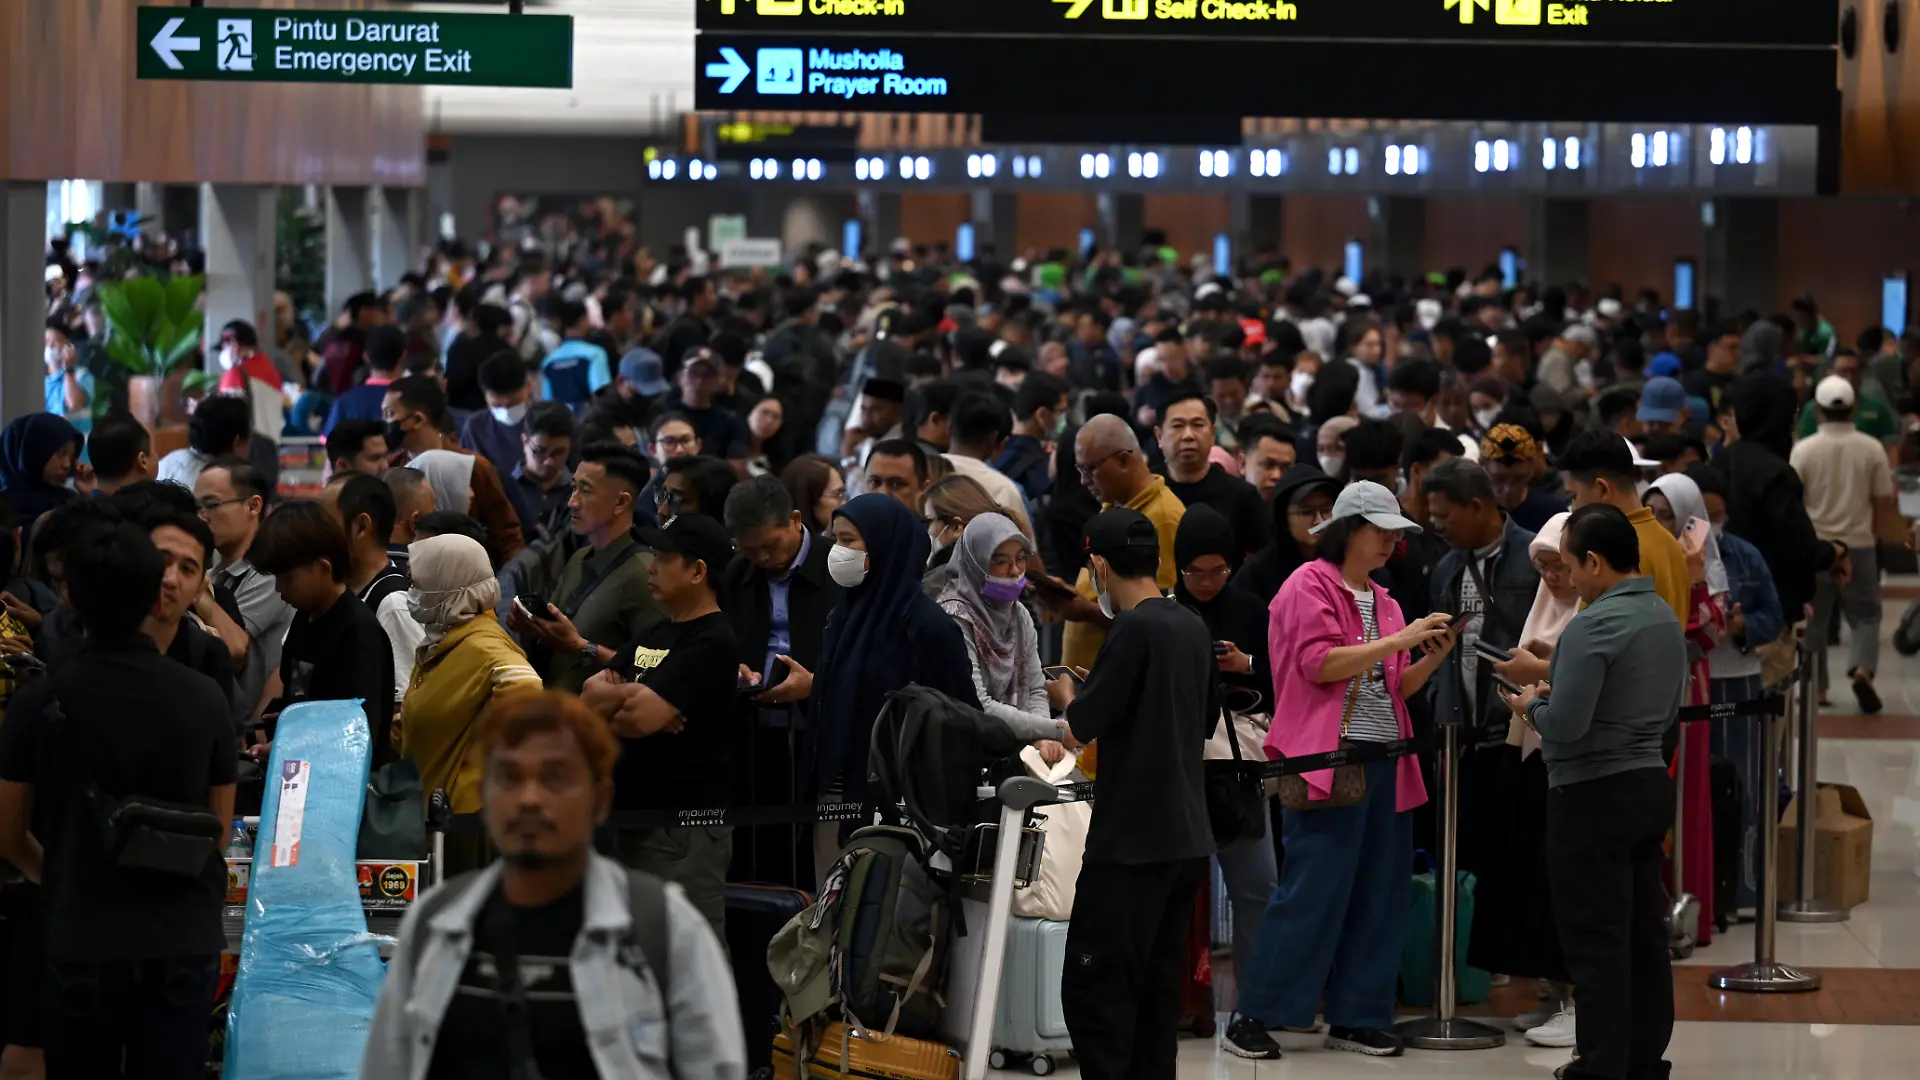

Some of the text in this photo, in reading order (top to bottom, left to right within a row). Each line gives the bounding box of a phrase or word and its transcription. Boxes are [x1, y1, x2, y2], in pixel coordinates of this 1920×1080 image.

[809, 0, 904, 16] Check-In
[1155, 0, 1296, 20] Self Check-In
[1547, 3, 1588, 25] Exit
[274, 17, 440, 42] Pintu Darurat
[275, 45, 471, 76] Emergency Exit
[809, 47, 904, 71] Musholla
[809, 72, 947, 99] Prayer Room
[818, 813, 861, 821] AIRPORTS
[384, 880, 406, 890] 1969
